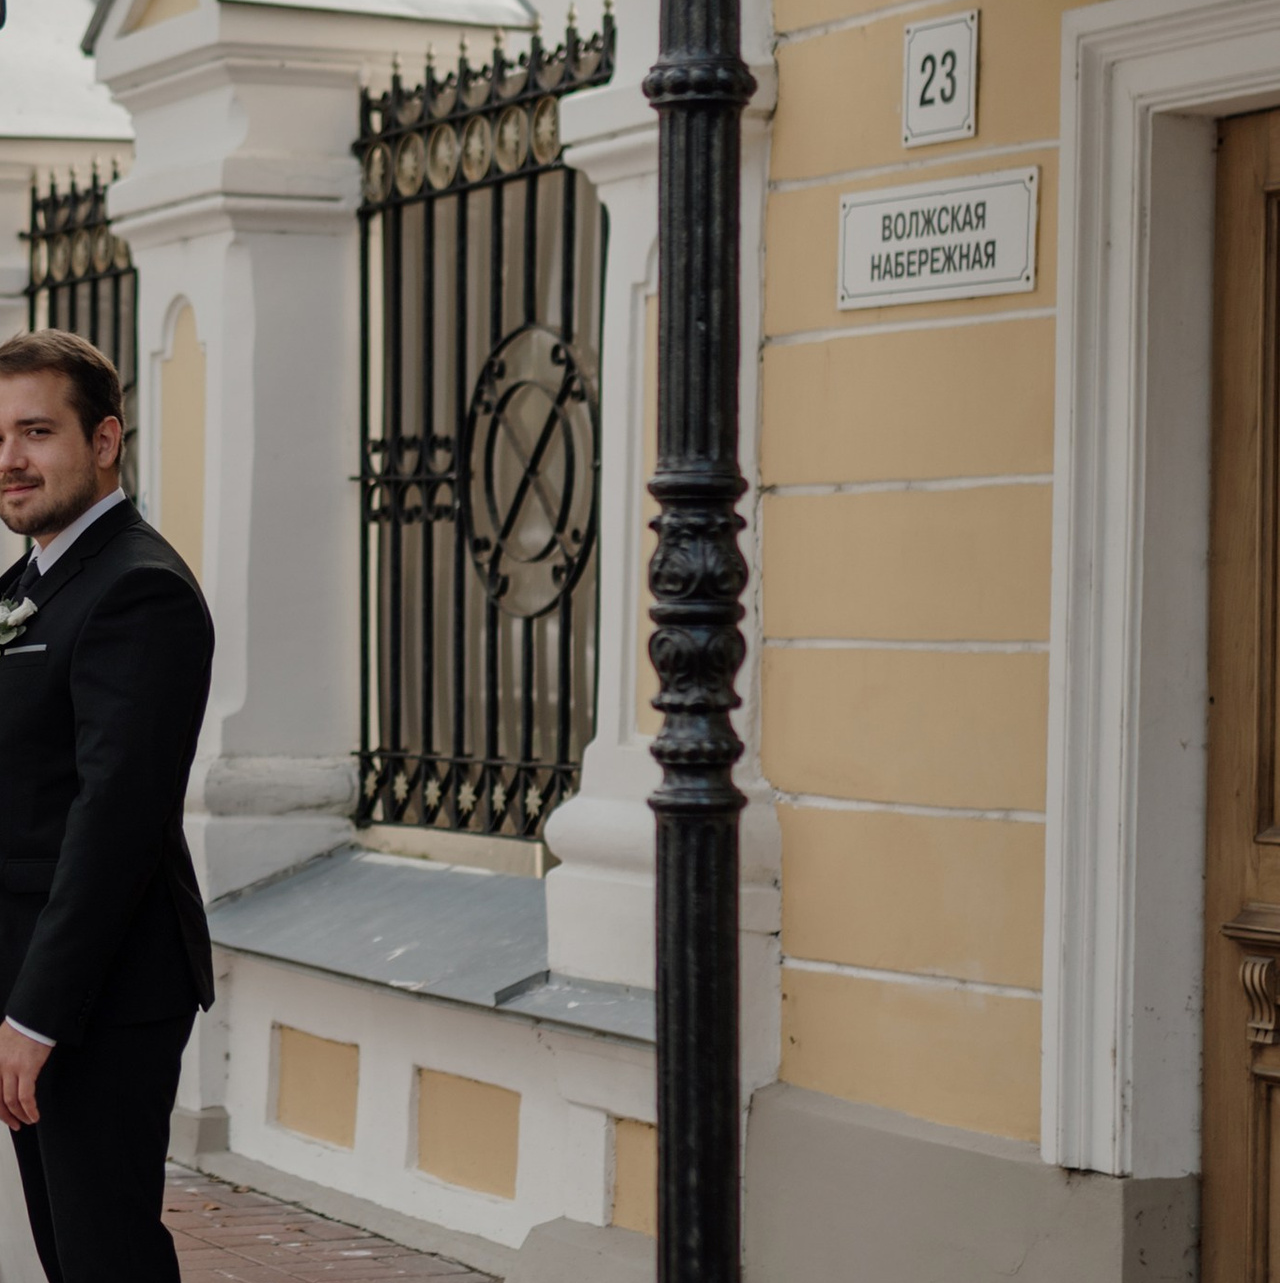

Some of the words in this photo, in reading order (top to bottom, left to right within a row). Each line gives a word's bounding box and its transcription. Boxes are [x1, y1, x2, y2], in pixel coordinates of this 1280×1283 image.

[919, 49, 957, 107] 23
[881, 201, 986, 241] ВОЛЖСКАЯ
[870, 240, 996, 281] НАБЕРЕЖНАЯ
